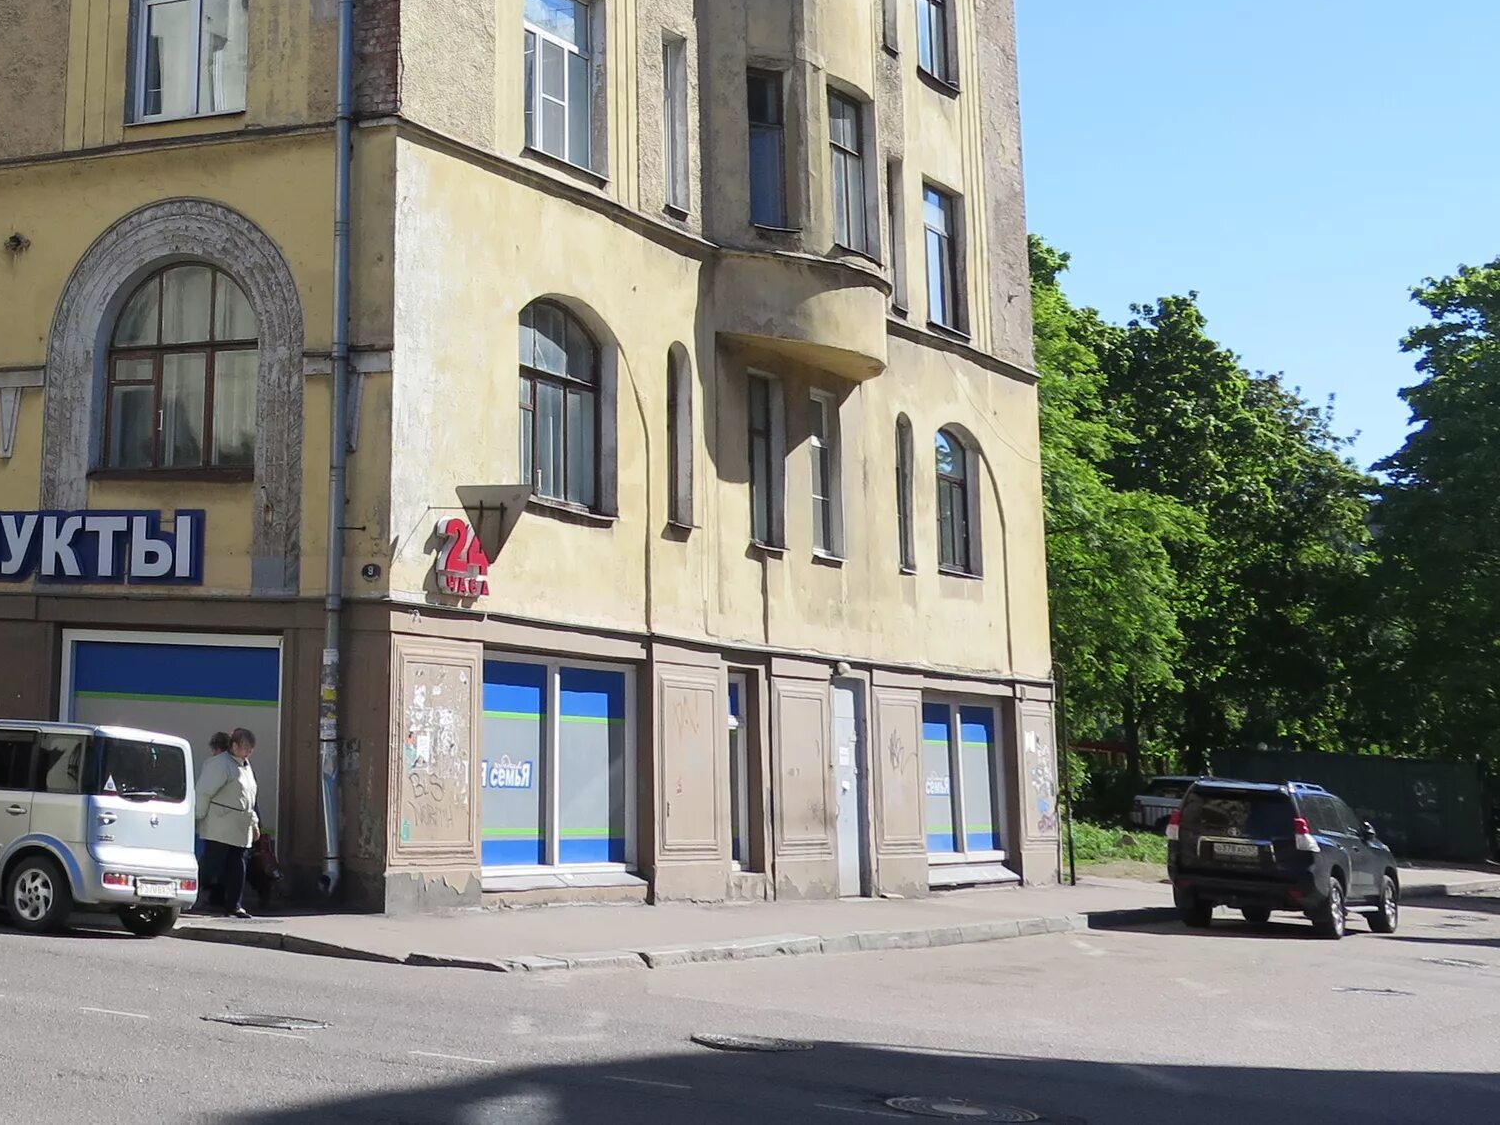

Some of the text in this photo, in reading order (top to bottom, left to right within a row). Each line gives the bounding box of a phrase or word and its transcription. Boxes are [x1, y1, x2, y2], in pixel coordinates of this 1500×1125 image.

[444, 518, 490, 576] 24
[367, 566, 374, 576] 9
[446, 575, 490, 596] ЧАСА
[490, 762, 531, 787] семьЯ
